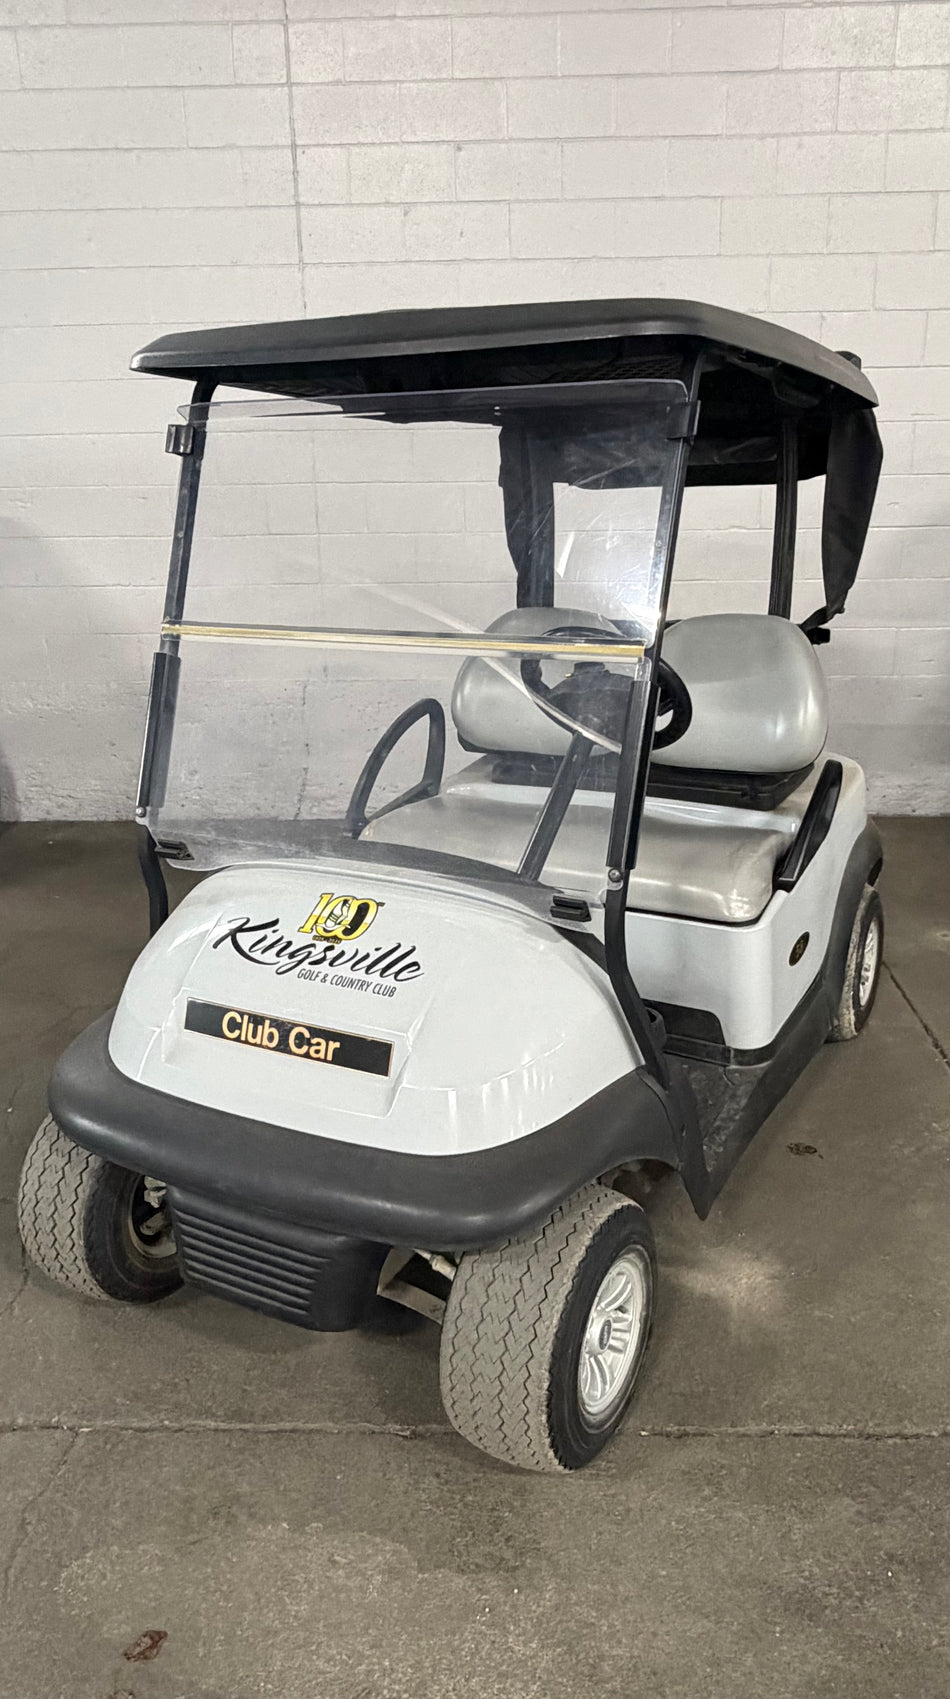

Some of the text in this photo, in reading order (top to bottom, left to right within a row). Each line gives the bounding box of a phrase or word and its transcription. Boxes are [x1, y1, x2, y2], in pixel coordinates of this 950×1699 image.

[297, 893, 379, 940] 100
[212, 916, 424, 982] Kingsville
[297, 968, 397, 998] GOLF & COUNTRY CLUB
[222, 1011, 341, 1062] Club Car
